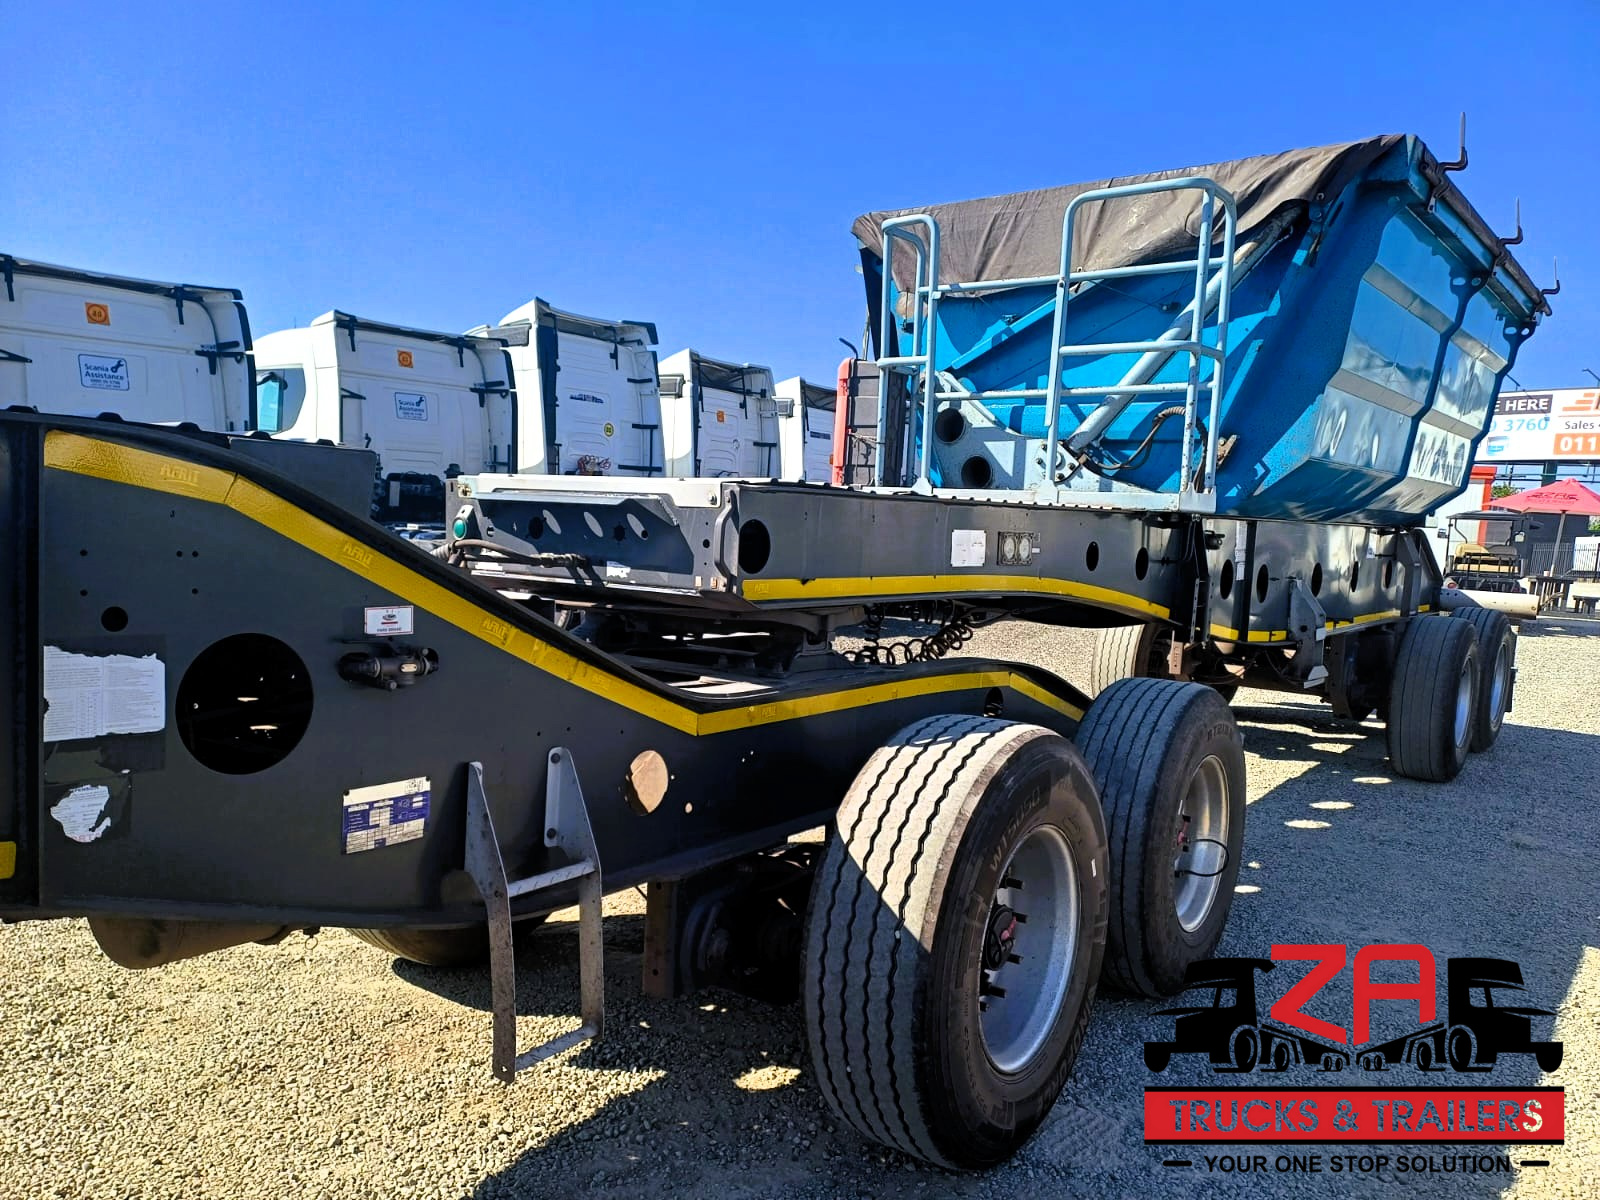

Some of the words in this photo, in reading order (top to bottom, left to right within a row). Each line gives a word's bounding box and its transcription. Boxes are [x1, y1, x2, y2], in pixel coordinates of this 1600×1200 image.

[84, 363, 109, 372] Scania
[85, 371, 124, 381] Assistance
[1505, 398, 1549, 412] HERE
[1503, 417, 1549, 432] 3760
[1564, 420, 1595, 430] Sales
[1559, 436, 1597, 452] 011
[343, 542, 374, 565] AFRIT
[482, 617, 506, 637] AFRIT
